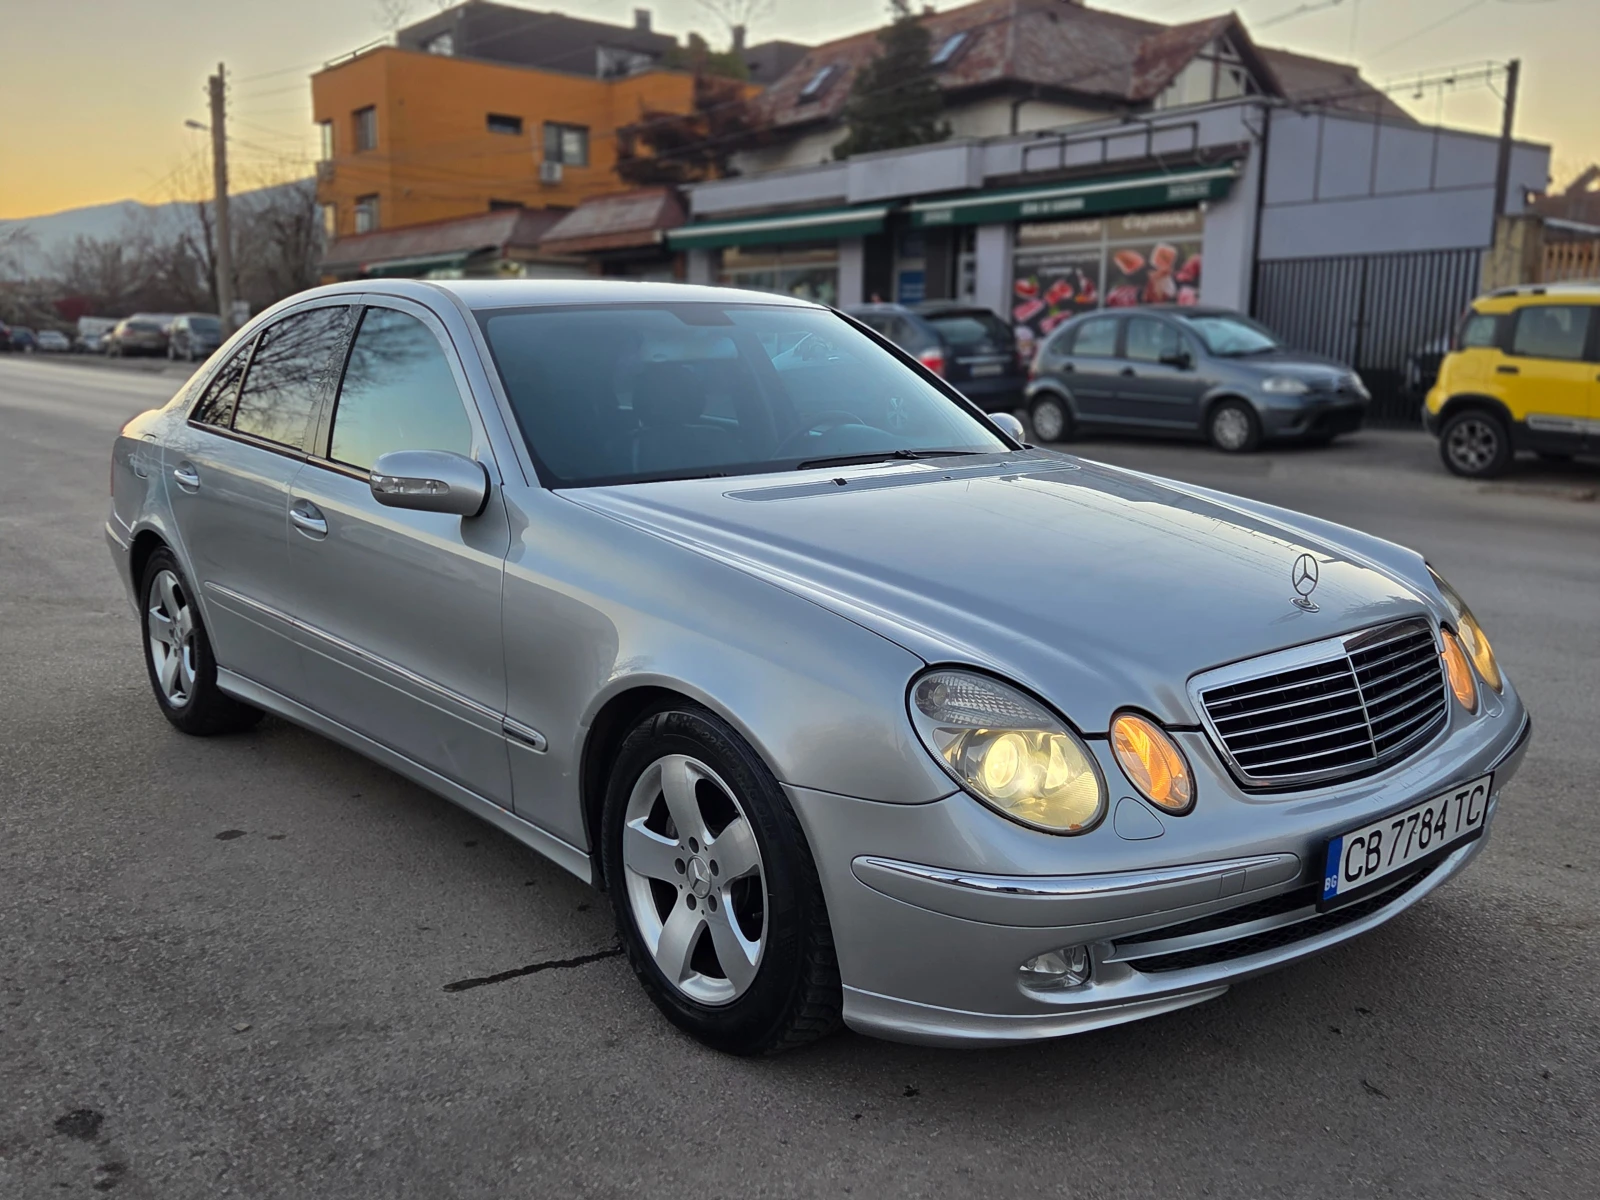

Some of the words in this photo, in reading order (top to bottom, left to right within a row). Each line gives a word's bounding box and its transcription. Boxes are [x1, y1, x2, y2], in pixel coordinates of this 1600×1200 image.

[1344, 829, 1383, 883] CB
[1387, 799, 1449, 866] 7784
[1455, 784, 1485, 833] TC
[1323, 874, 1338, 891] BG
